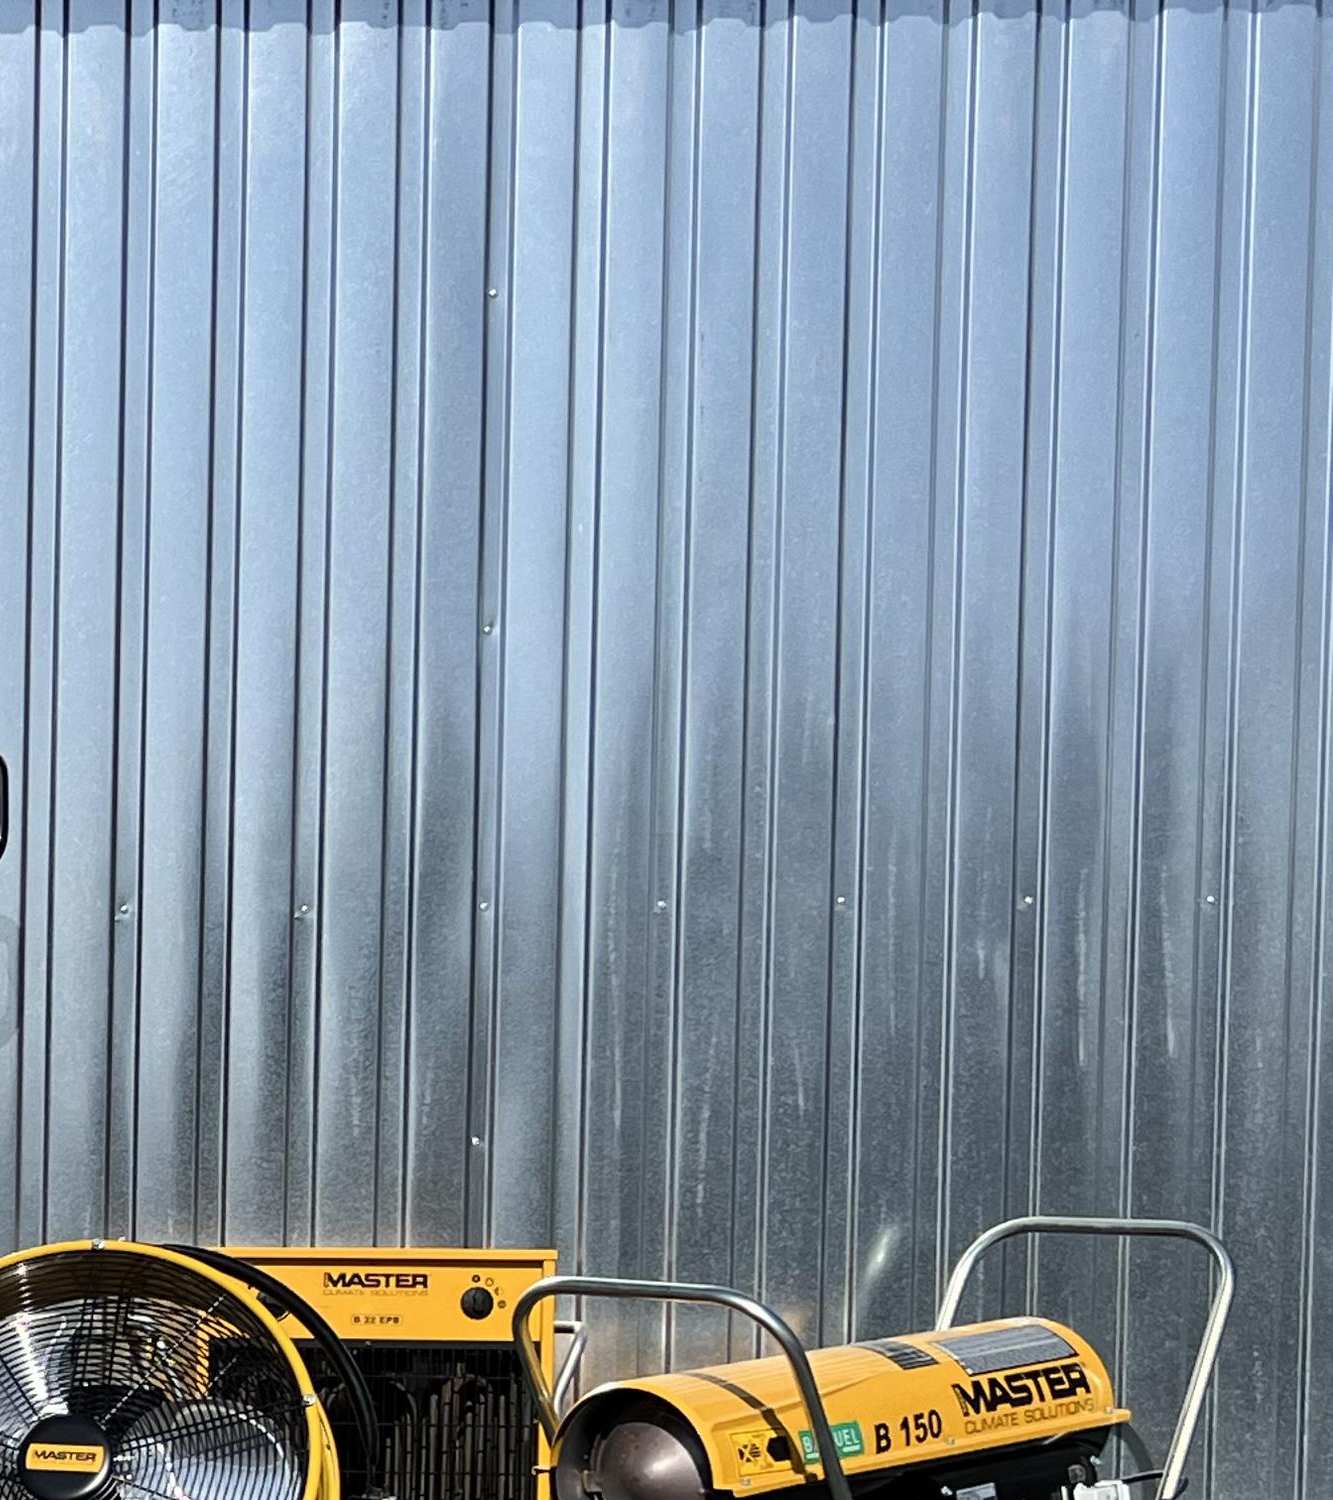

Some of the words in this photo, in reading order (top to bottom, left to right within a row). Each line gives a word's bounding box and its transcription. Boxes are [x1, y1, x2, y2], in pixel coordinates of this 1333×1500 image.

[323, 1272, 428, 1288] MASTER
[951, 1363, 1091, 1417] MASTER
[874, 1422, 892, 1454] B
[900, 1409, 943, 1447] 150
[965, 1412, 1020, 1435] CLIMATE
[1024, 1398, 1095, 1424] SOLUTIONS
[35, 1451, 97, 1462] MASTER
